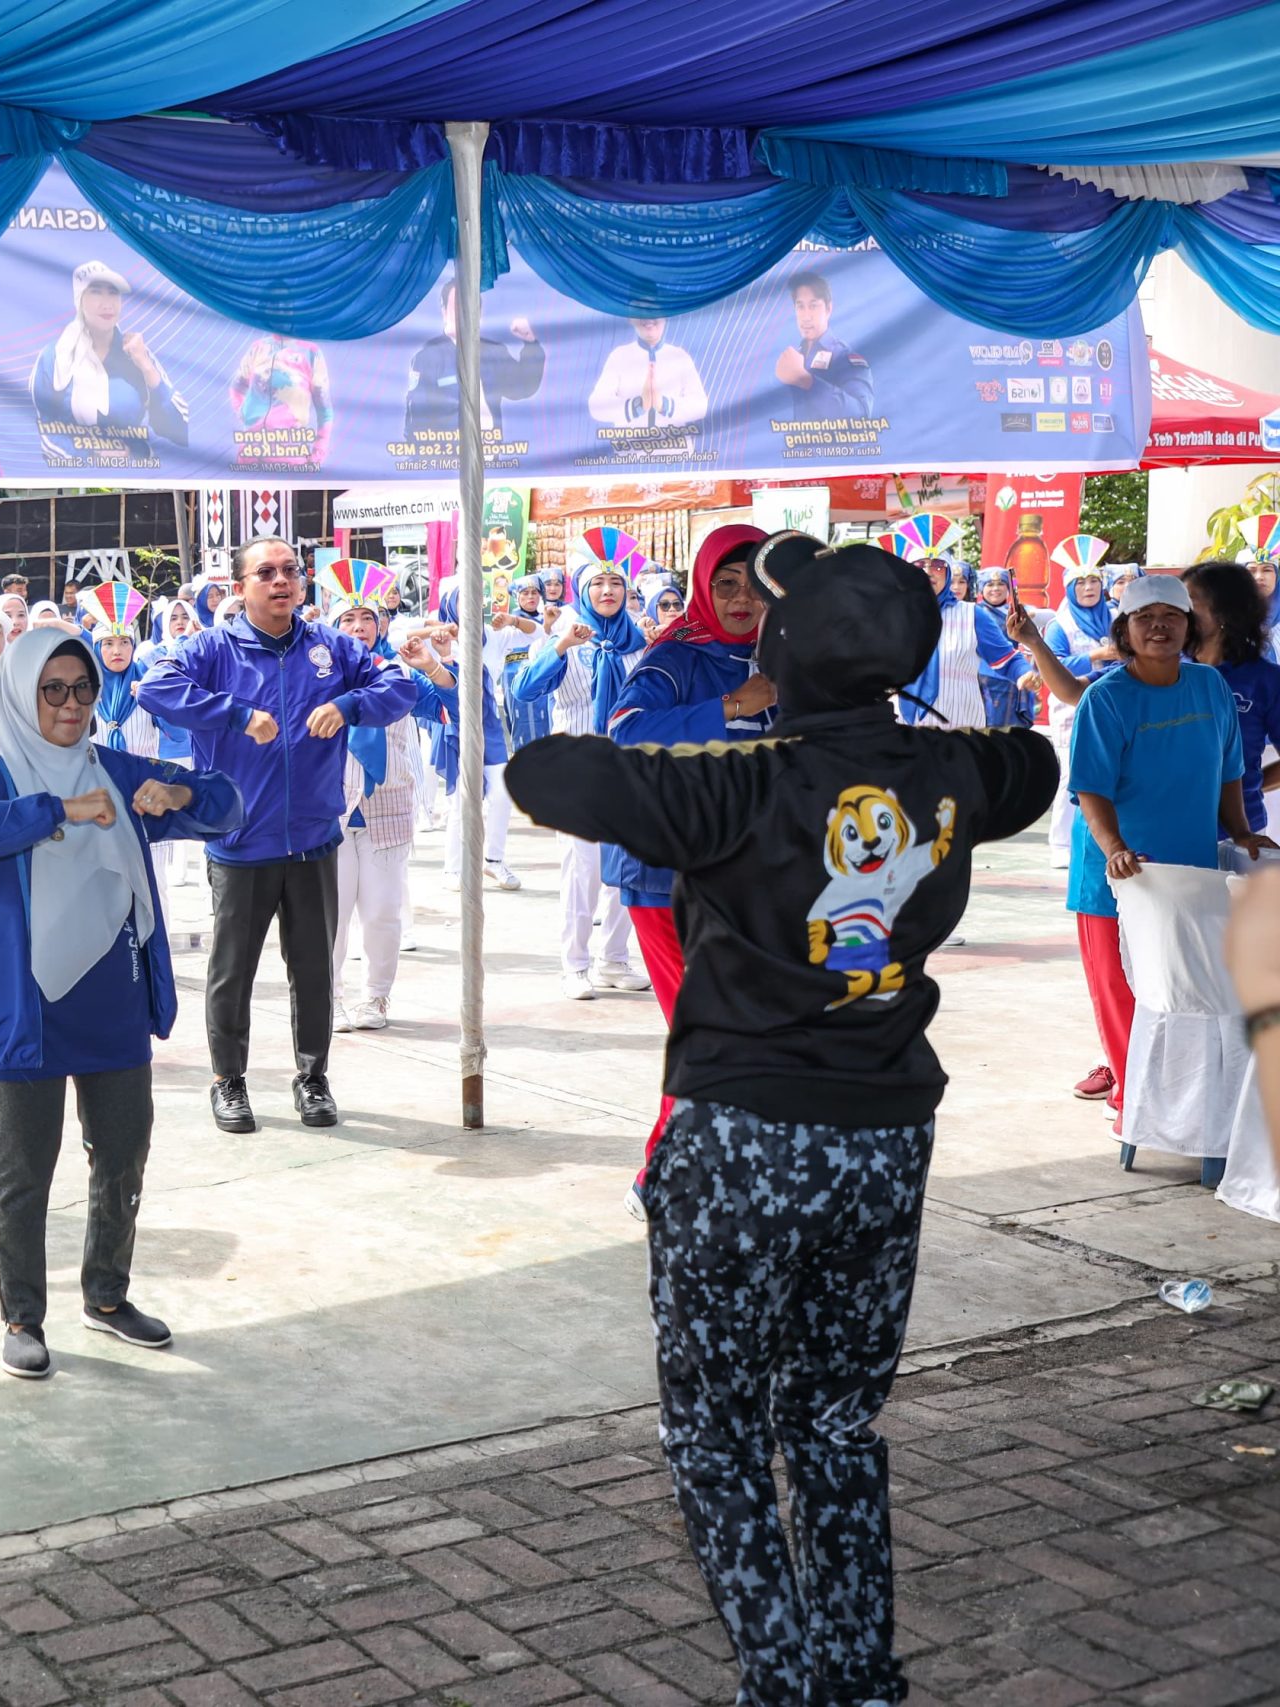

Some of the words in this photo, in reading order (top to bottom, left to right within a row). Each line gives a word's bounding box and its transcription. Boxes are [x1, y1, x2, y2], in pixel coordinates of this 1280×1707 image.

[1153, 432, 1173, 446] Teh
[1173, 431, 1214, 446] Terbaik
[1215, 431, 1236, 446] ada
[1236, 431, 1247, 446] di
[332, 502, 434, 521] www.smartfren.com
